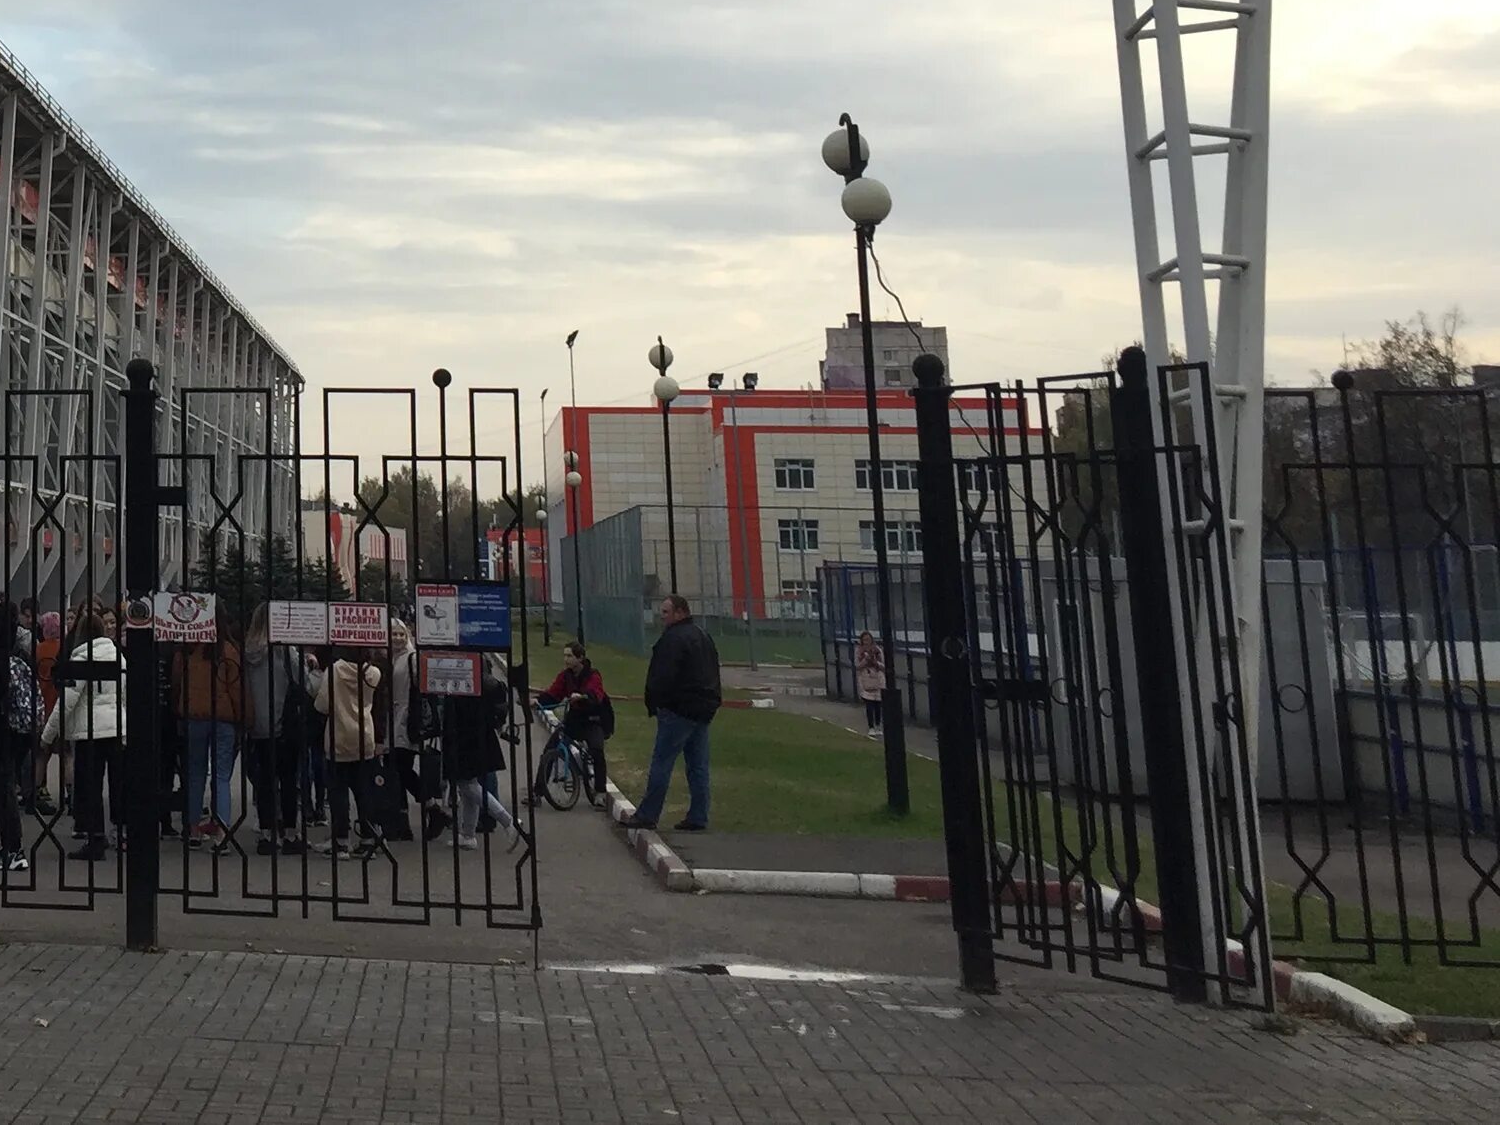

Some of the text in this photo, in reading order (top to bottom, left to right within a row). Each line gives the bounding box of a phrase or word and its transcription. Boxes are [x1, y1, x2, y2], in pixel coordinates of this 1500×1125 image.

[335, 607, 381, 617] КУРЕНИЕ
[187, 617, 215, 630] СОБАК
[342, 615, 381, 625] РАСПИТИЕ
[331, 629, 386, 642] ЗАПРЕЩЕНО!
